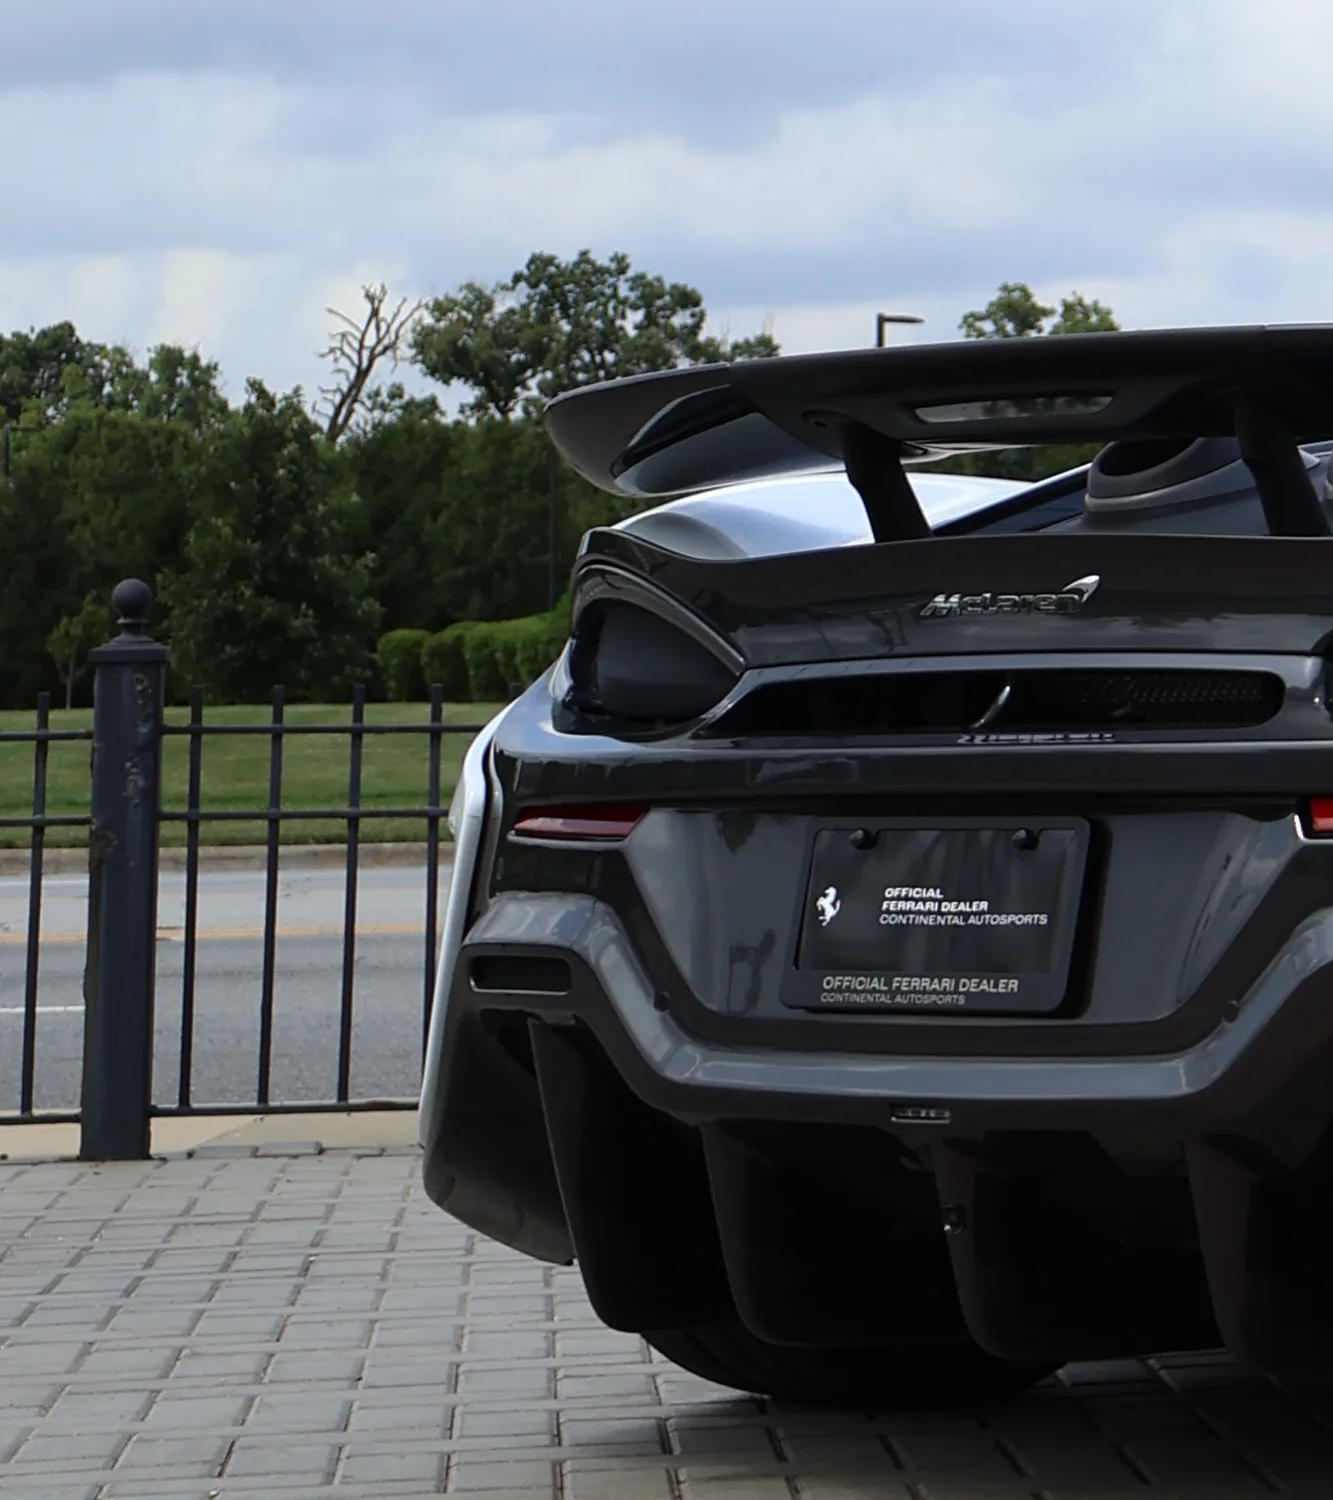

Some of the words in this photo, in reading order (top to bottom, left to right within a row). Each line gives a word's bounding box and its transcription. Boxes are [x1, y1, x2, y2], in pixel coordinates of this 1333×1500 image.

[920, 592, 1083, 616] McLaren
[884, 887, 944, 899] OFFICIAL
[881, 900, 939, 912] FERRARI
[940, 901, 989, 912] DEALER
[879, 913, 966, 925] CONTINENTAL
[968, 913, 1049, 926] AUTOSPORTS
[822, 976, 889, 991] OFFICIAL
[891, 977, 955, 992] FERRARI
[958, 978, 1020, 993] DEALER
[820, 993, 892, 1004] CONTINENTAL
[893, 993, 967, 1006] AUTOSPORTS
